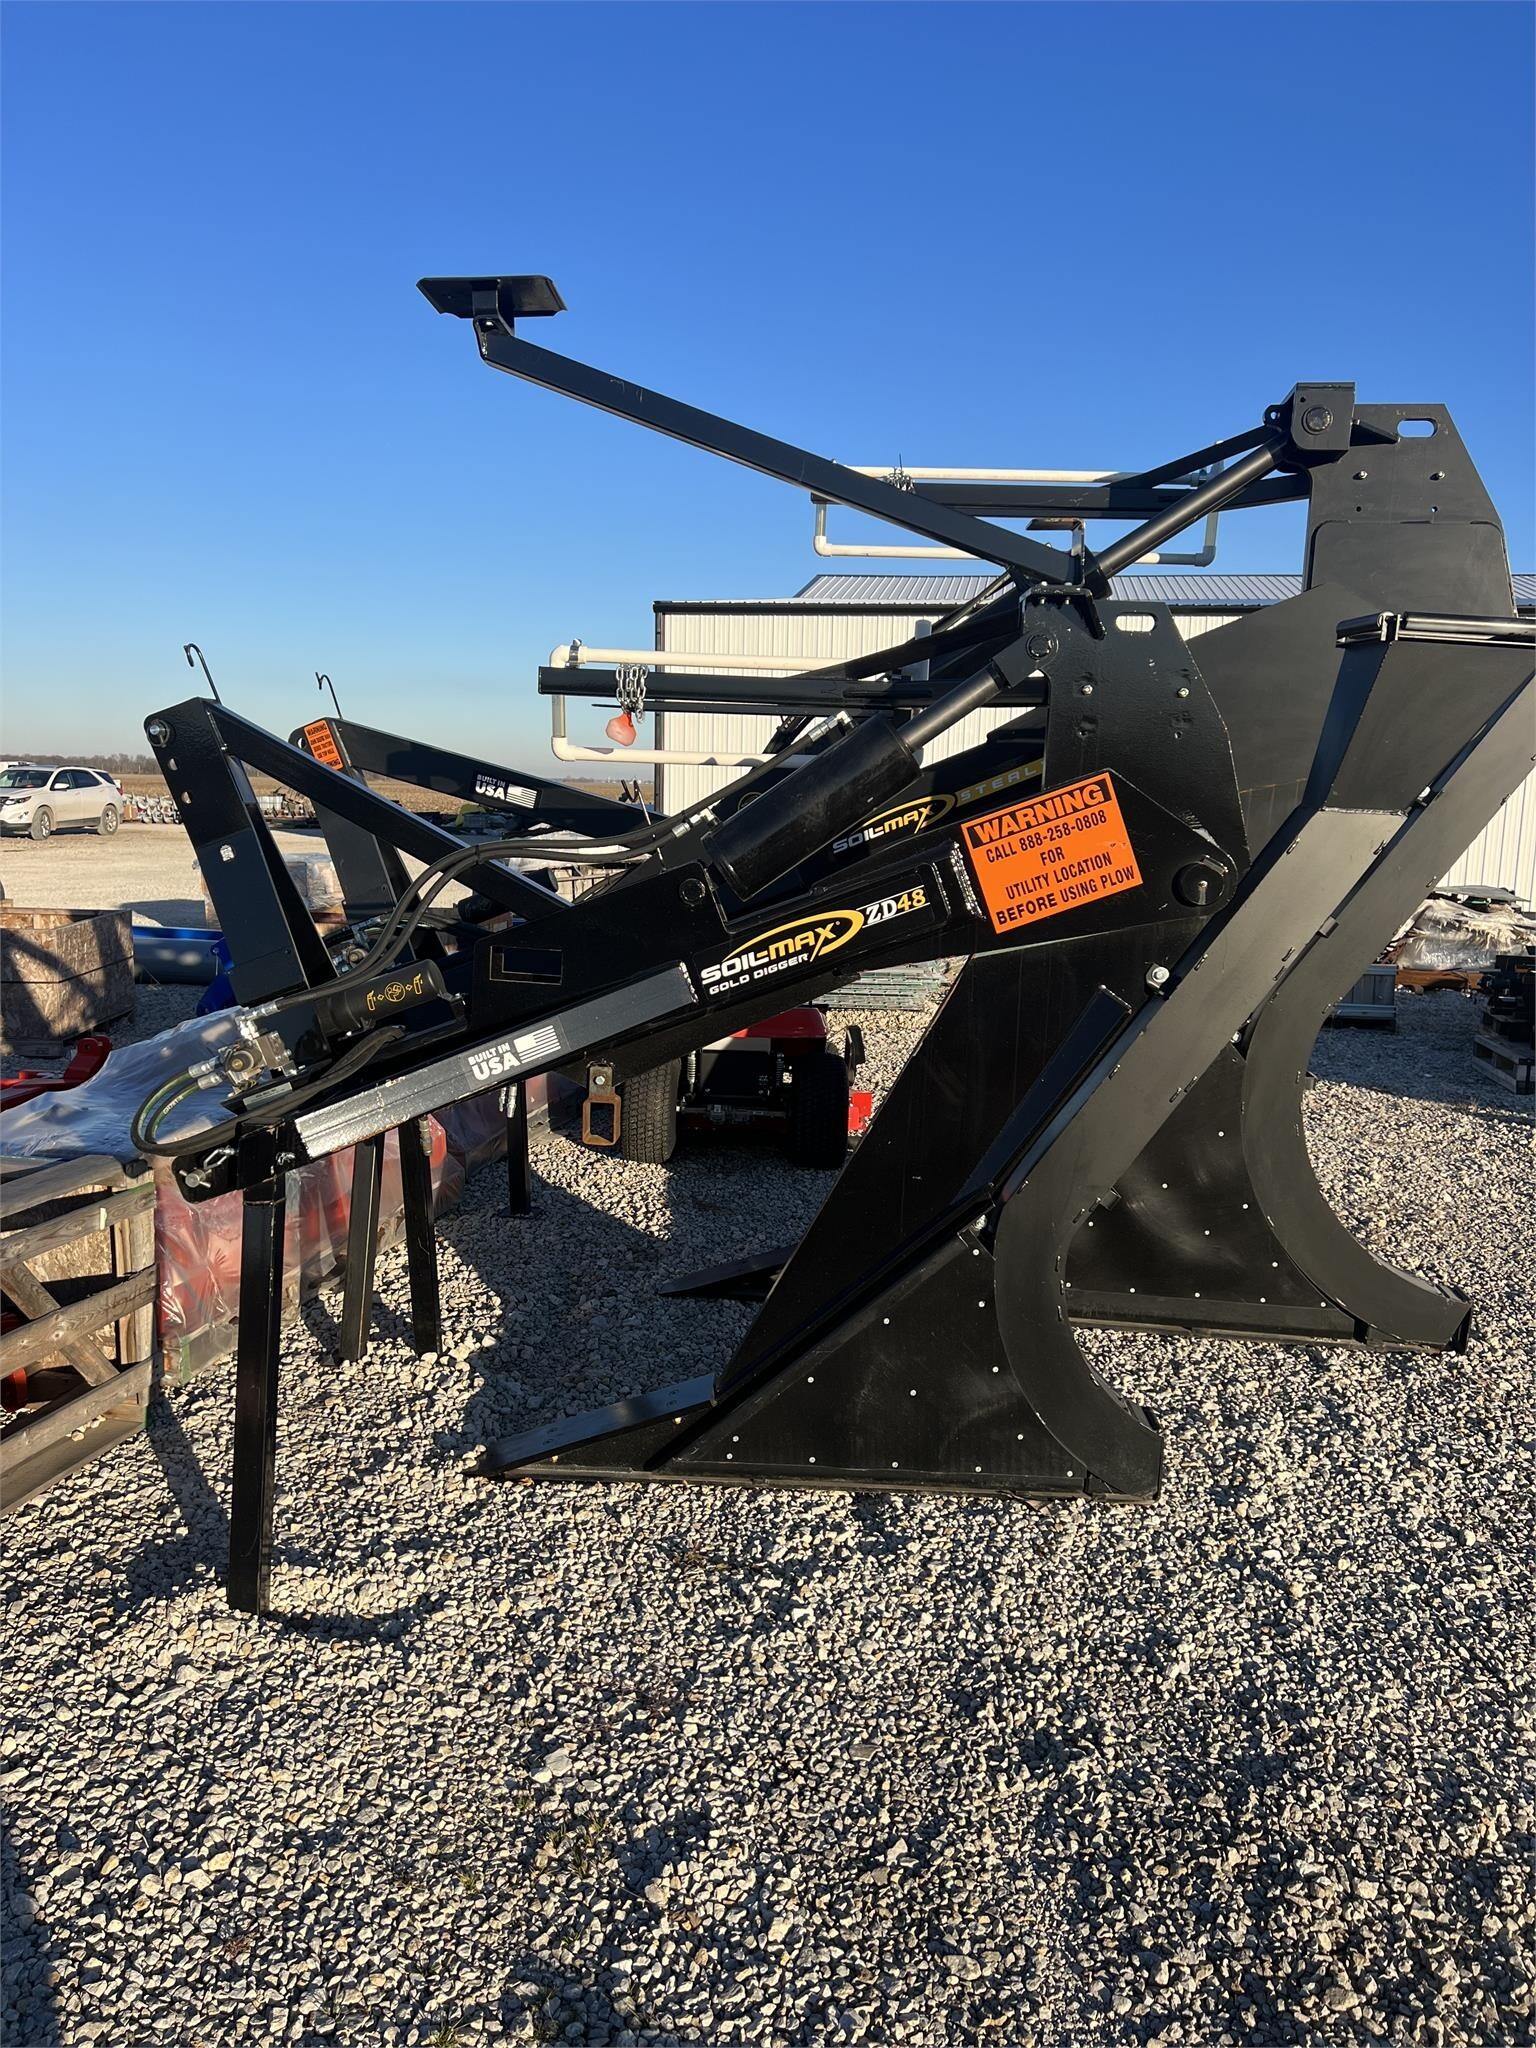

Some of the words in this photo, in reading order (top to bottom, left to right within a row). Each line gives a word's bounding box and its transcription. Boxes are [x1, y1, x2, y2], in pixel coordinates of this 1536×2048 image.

[475, 780, 505, 800] USA
[476, 774, 497, 785] BUILT
[497, 780, 506, 788] IN
[960, 760, 1043, 801] STEAL
[832, 804, 934, 854] SOIL-MAX
[973, 784, 1105, 844] WARNING
[986, 843, 1017, 864] CALL
[1018, 809, 1107, 851] 888-258-0808
[1040, 846, 1065, 866] FOR
[996, 893, 1058, 925] BEFORE
[1059, 880, 1098, 903] USING
[1100, 865, 1135, 889] PLOW
[1005, 873, 1050, 900] UTILITY
[1053, 852, 1113, 884] LOCATION
[865, 888, 927, 925] ZD48
[700, 922, 837, 985] SOIL-MAX
[709, 974, 750, 995] GOLD
[753, 953, 809, 980] DIGGER
[467, 1047, 497, 1066] BUILT
[498, 1042, 511, 1054] IN
[471, 1051, 521, 1080] USA
